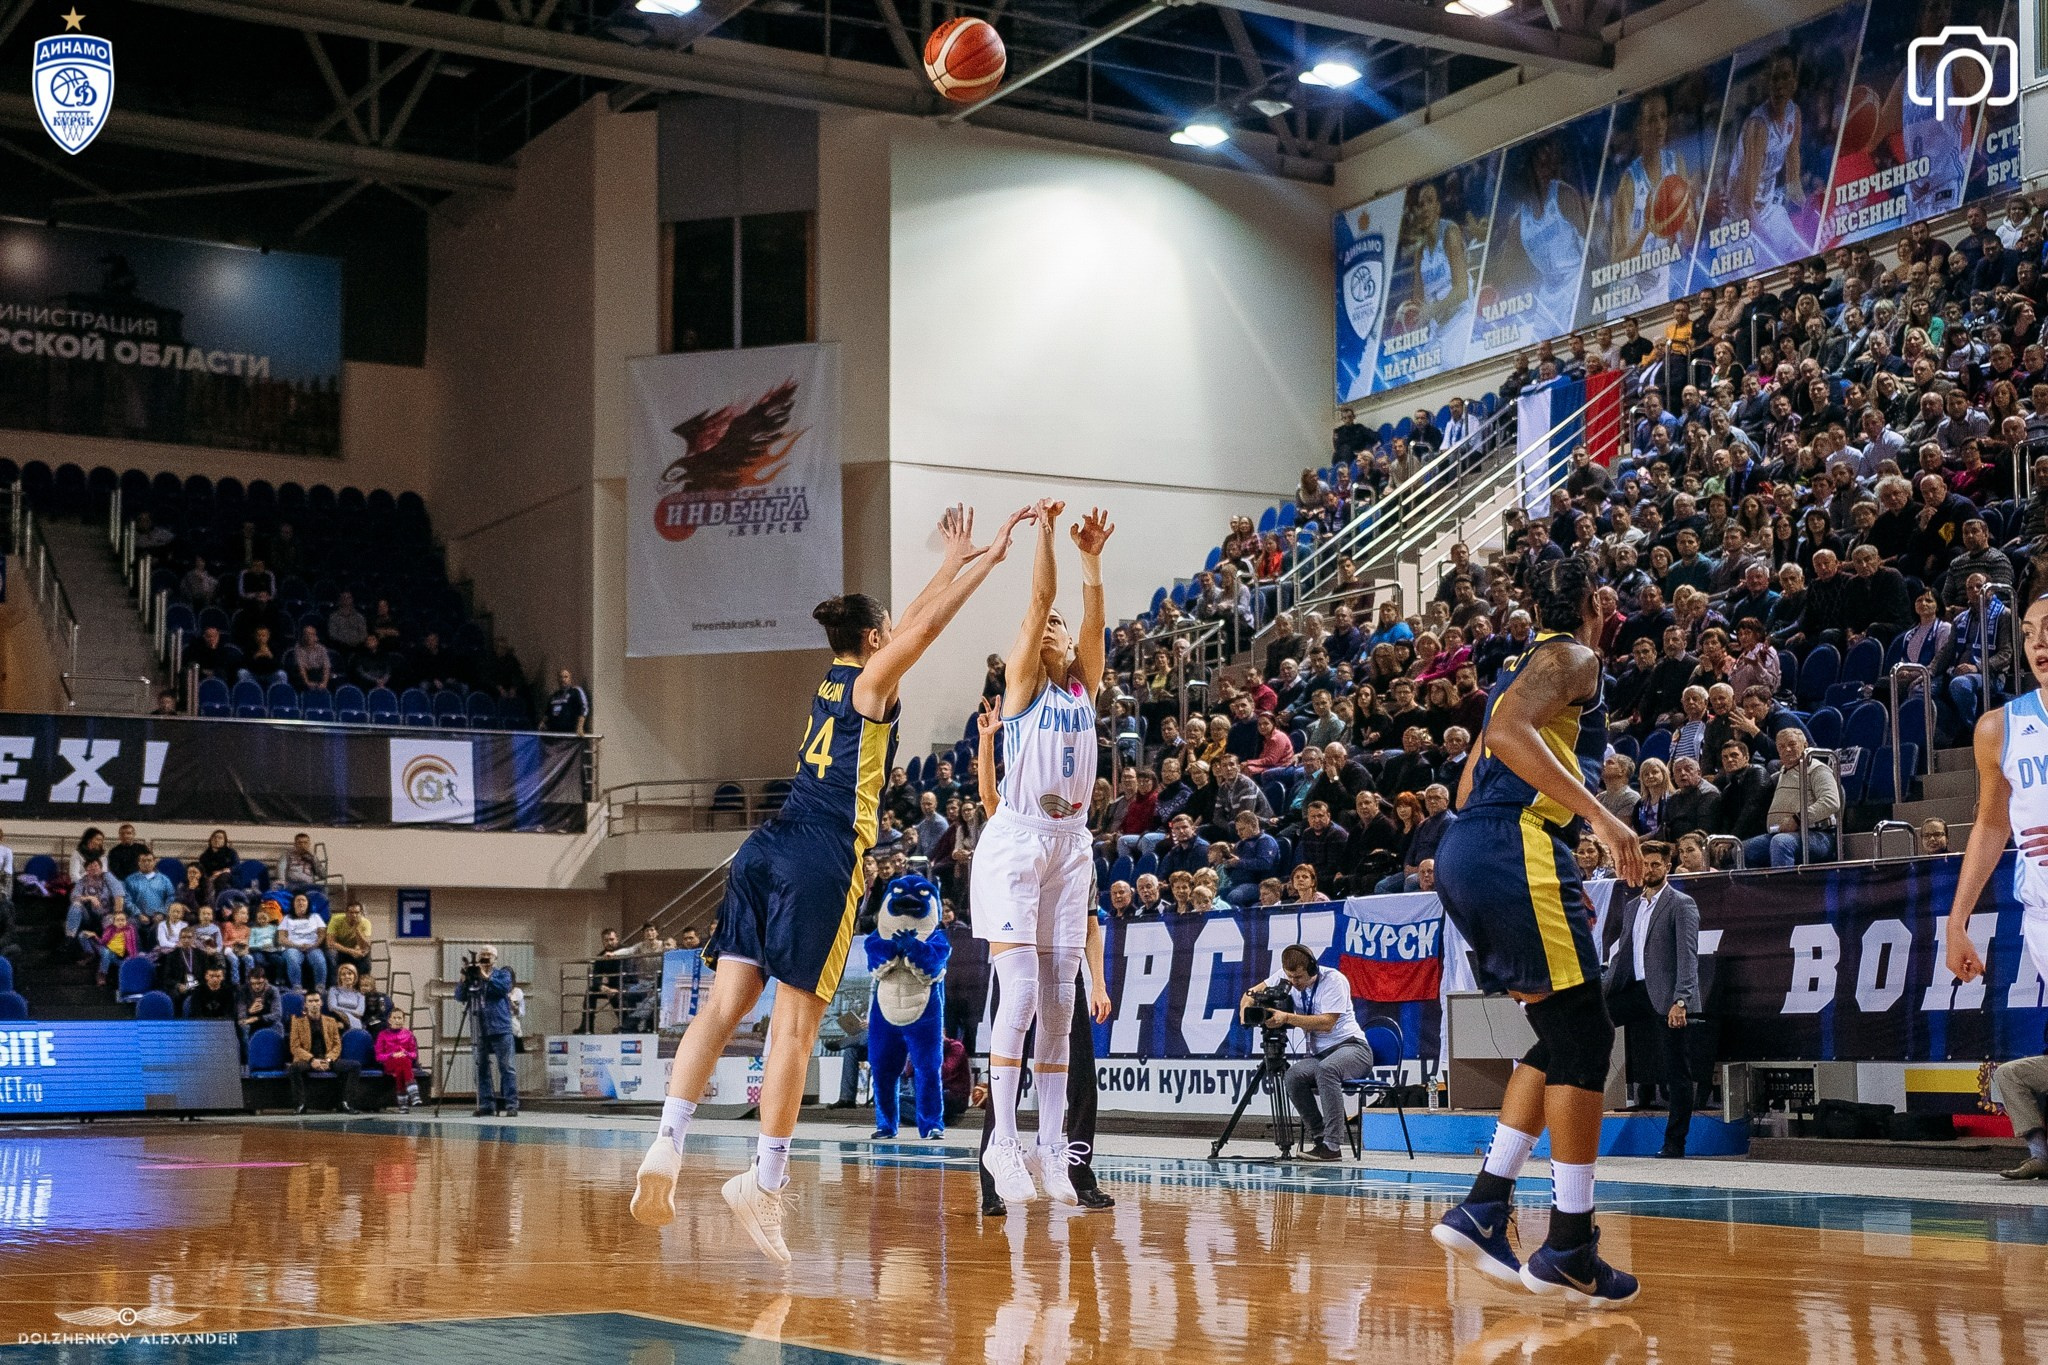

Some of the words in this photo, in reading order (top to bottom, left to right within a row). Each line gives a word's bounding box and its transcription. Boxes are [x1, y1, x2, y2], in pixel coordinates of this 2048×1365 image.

[1835, 195, 1908, 236] КСЕНИЯ
[1709, 219, 1751, 249] КРУЗ
[1709, 247, 1756, 278] АННА
[113, 340, 270, 379] ОБЛАСТИ
[1383, 349, 1442, 381] НАТАЛЬЯ
[665, 494, 810, 526] ИНВЕНТА
[1039, 705, 1095, 733] DYNAM
[1062, 746, 1075, 778] 5
[402, 901, 426, 934] F
[1345, 917, 1440, 960] КУРСК
